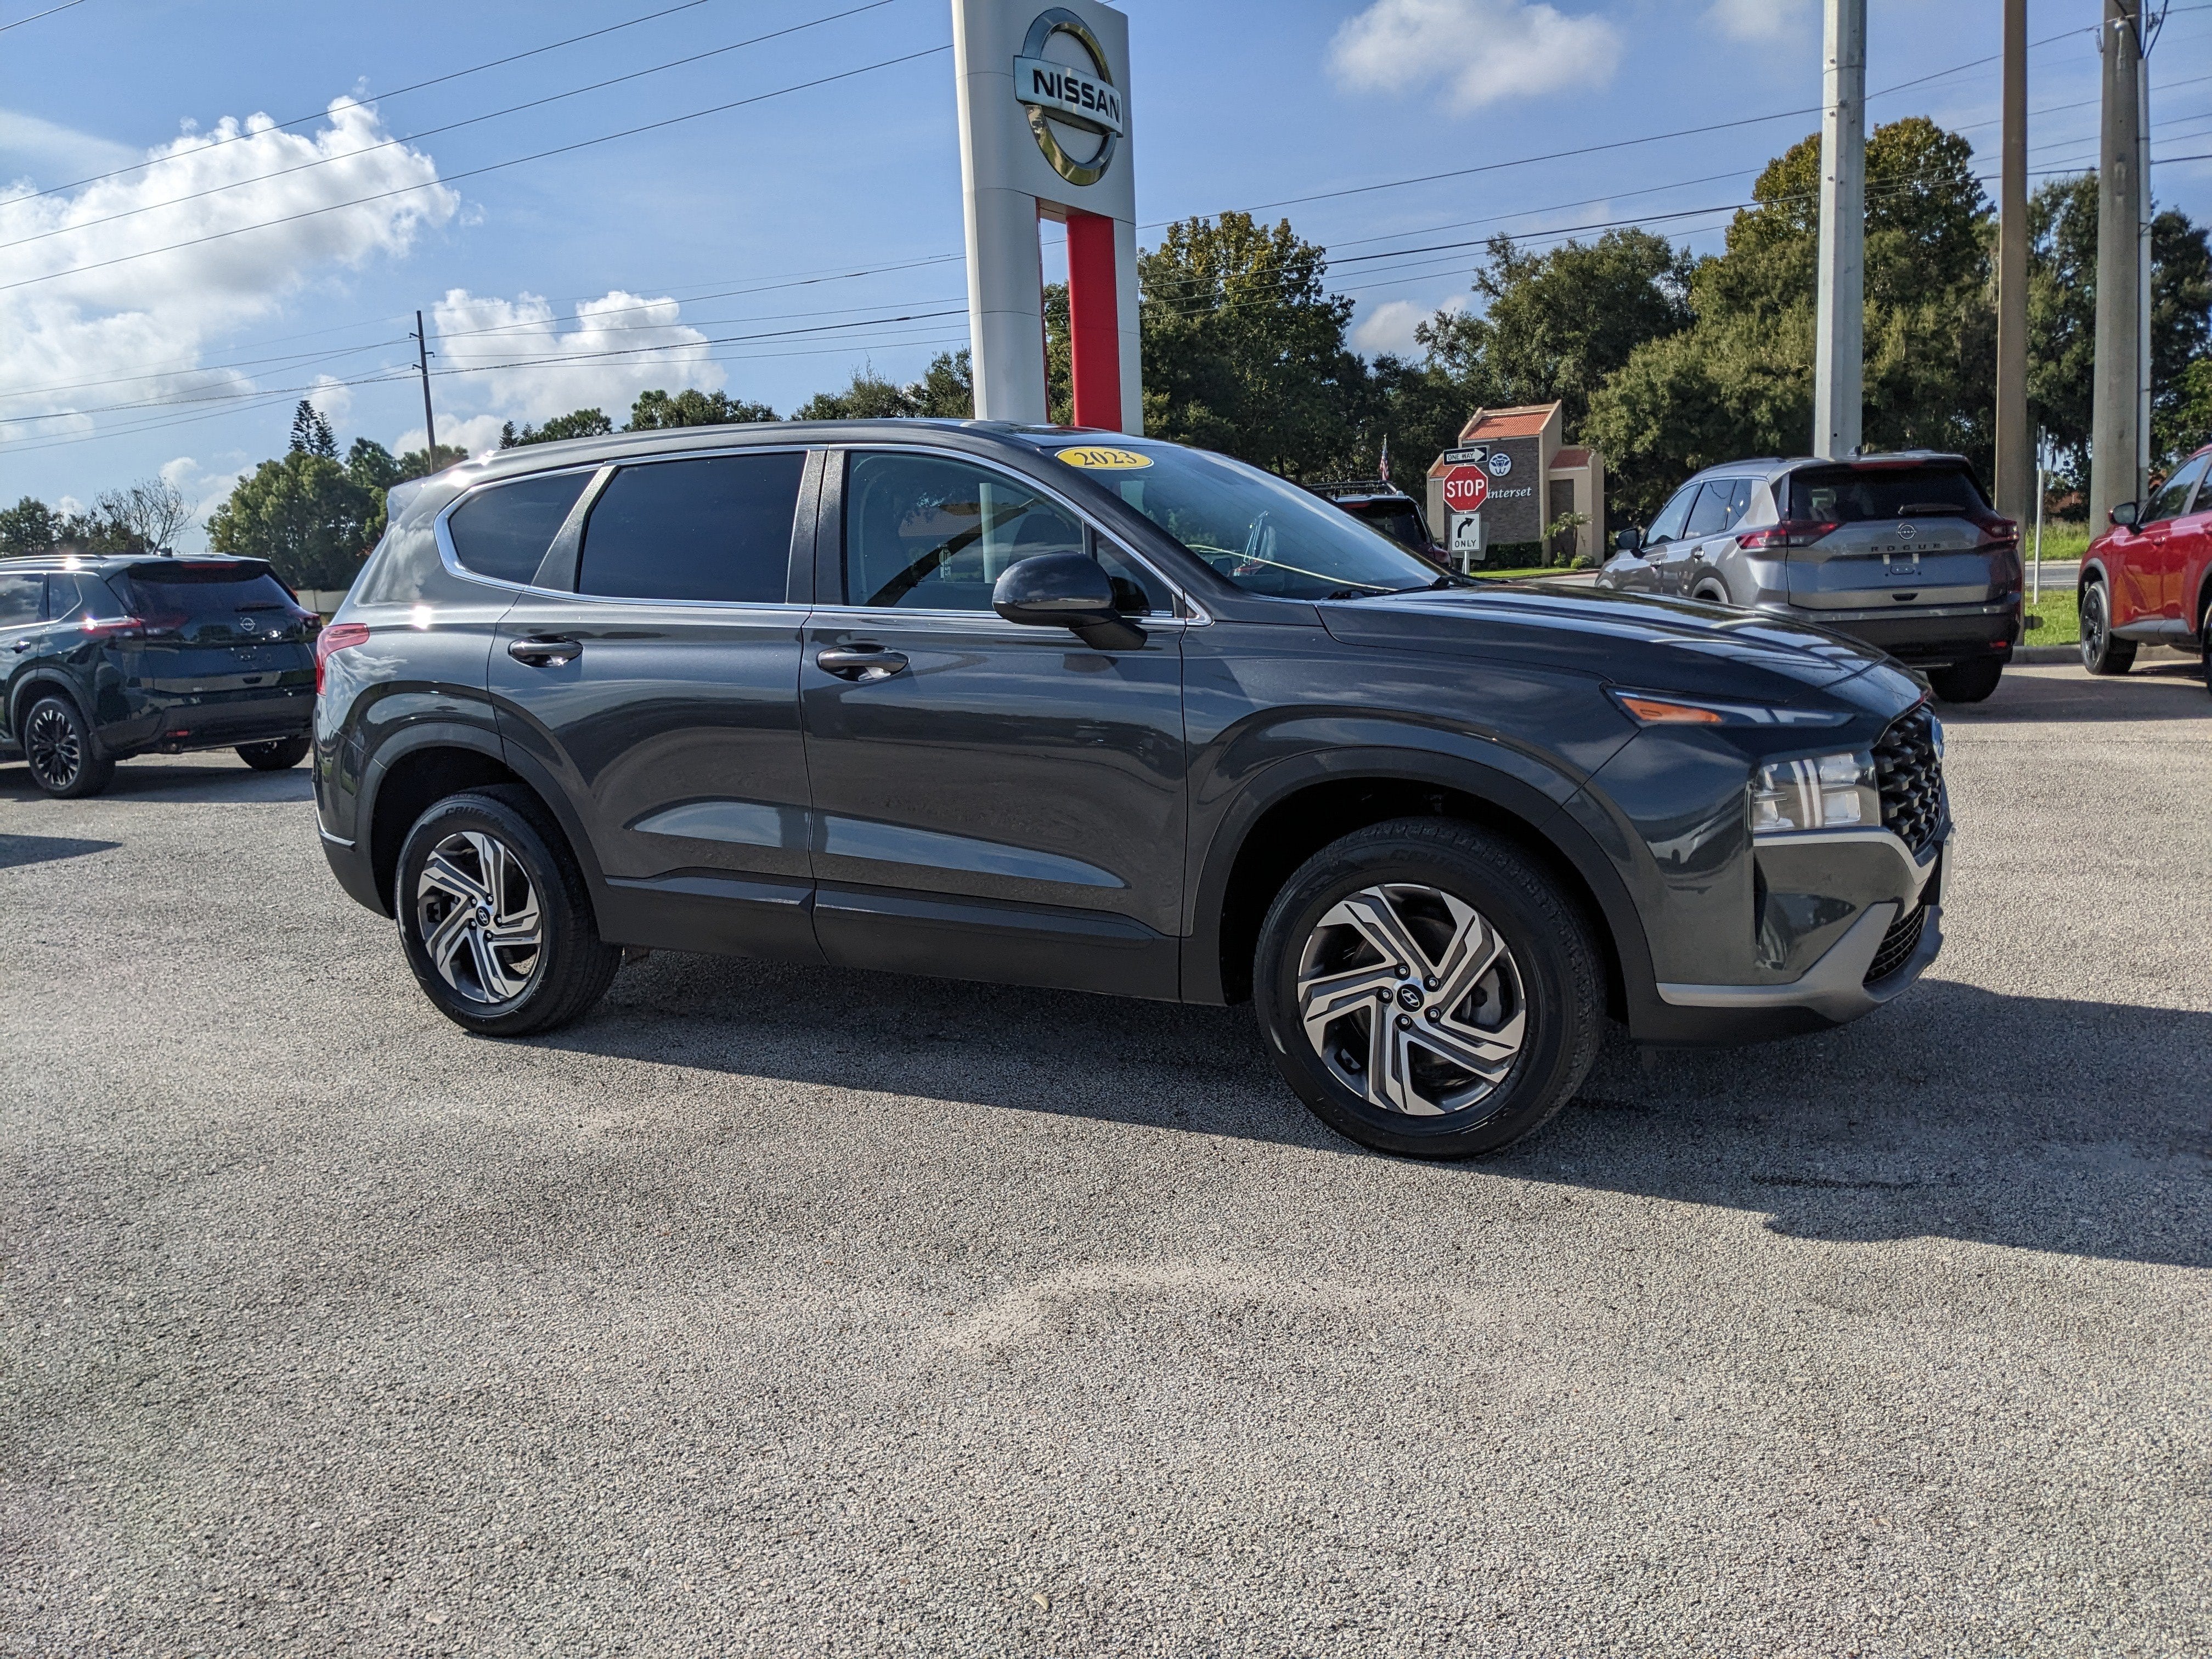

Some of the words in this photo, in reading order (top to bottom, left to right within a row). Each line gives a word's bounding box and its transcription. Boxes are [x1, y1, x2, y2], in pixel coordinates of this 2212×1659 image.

[1033, 68, 1120, 123] NISSAN
[1074, 451, 1137, 466] 2023
[1446, 479, 1485, 498] STOP
[1487, 487, 1532, 499] interset
[1455, 539, 1476, 548] ONLY
[1871, 543, 1940, 551] ROGUE
